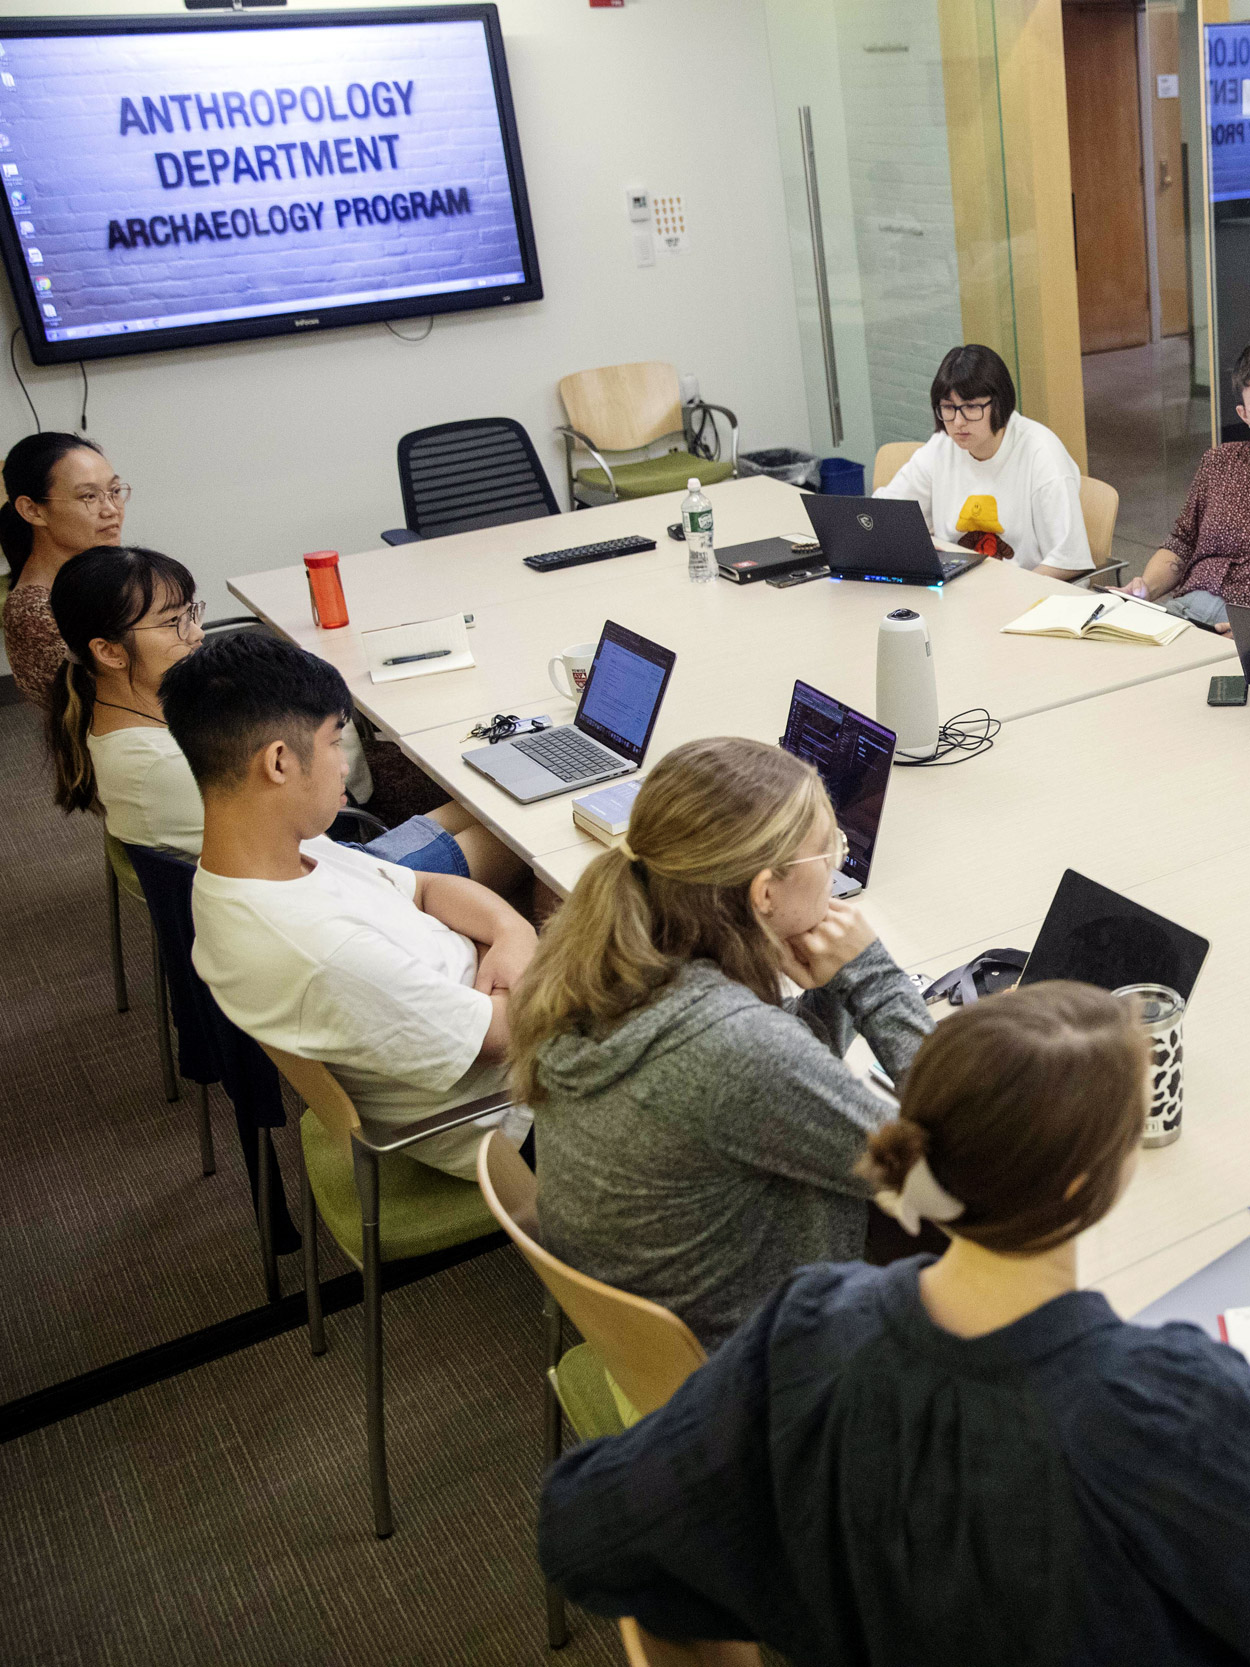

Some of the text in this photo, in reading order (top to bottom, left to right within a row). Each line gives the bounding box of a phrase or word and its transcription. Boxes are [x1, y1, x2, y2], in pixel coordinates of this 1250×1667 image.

[119, 80, 415, 136] ANTHROPOLOGY
[155, 133, 400, 190] DEPARTMENT
[108, 187, 471, 251] ARCHAEOLOGY PROGRAM
